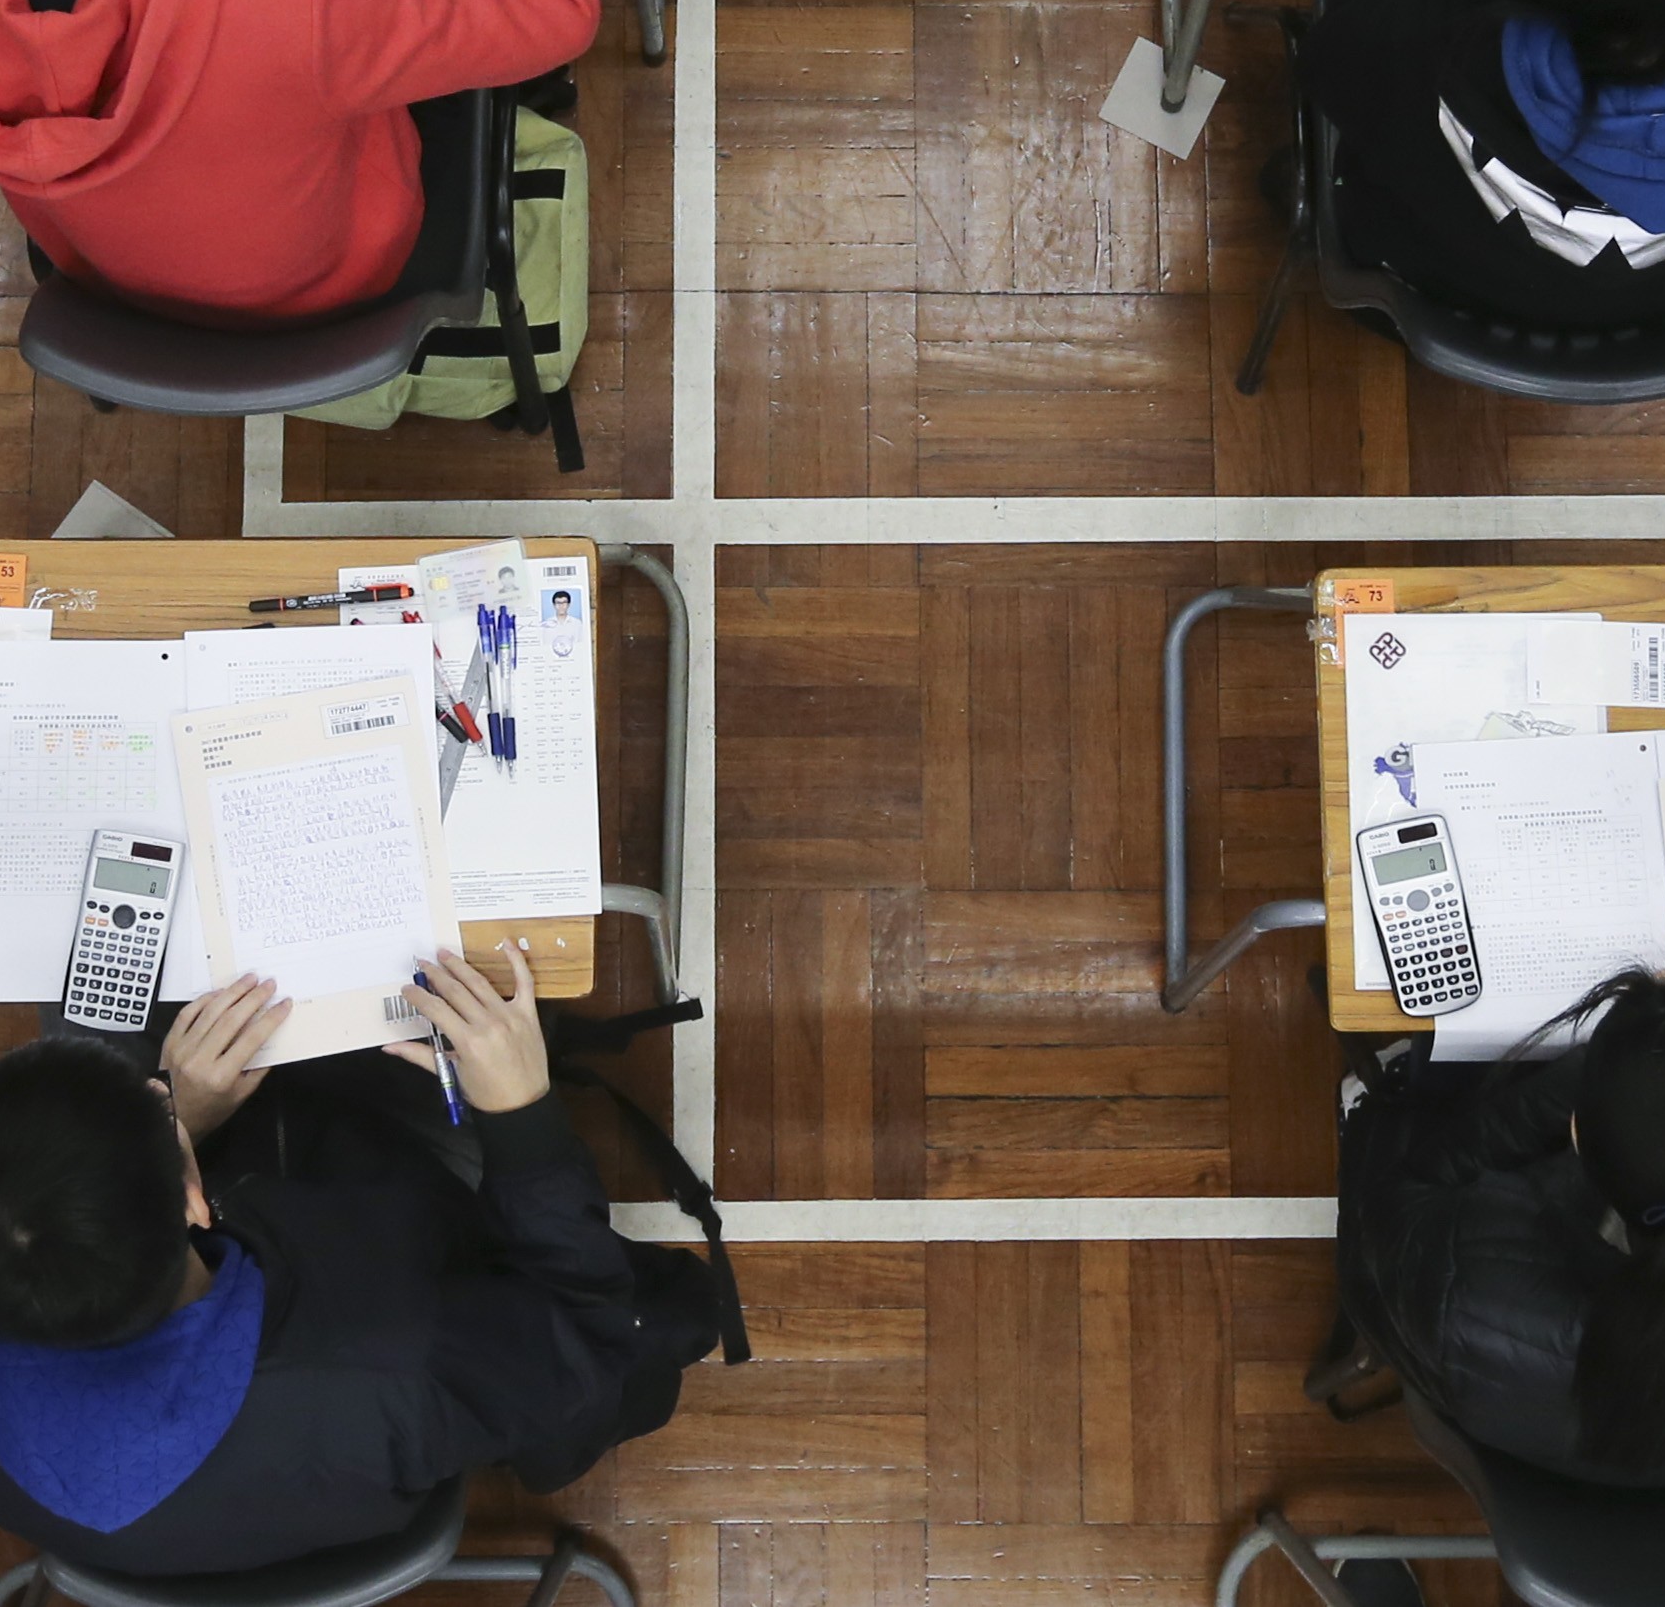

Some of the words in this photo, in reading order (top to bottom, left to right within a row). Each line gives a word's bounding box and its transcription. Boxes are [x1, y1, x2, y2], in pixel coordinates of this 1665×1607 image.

[0, 566, 15, 577] 53
[1369, 590, 1383, 601] 73
[1369, 831, 1390, 840] CASIO
